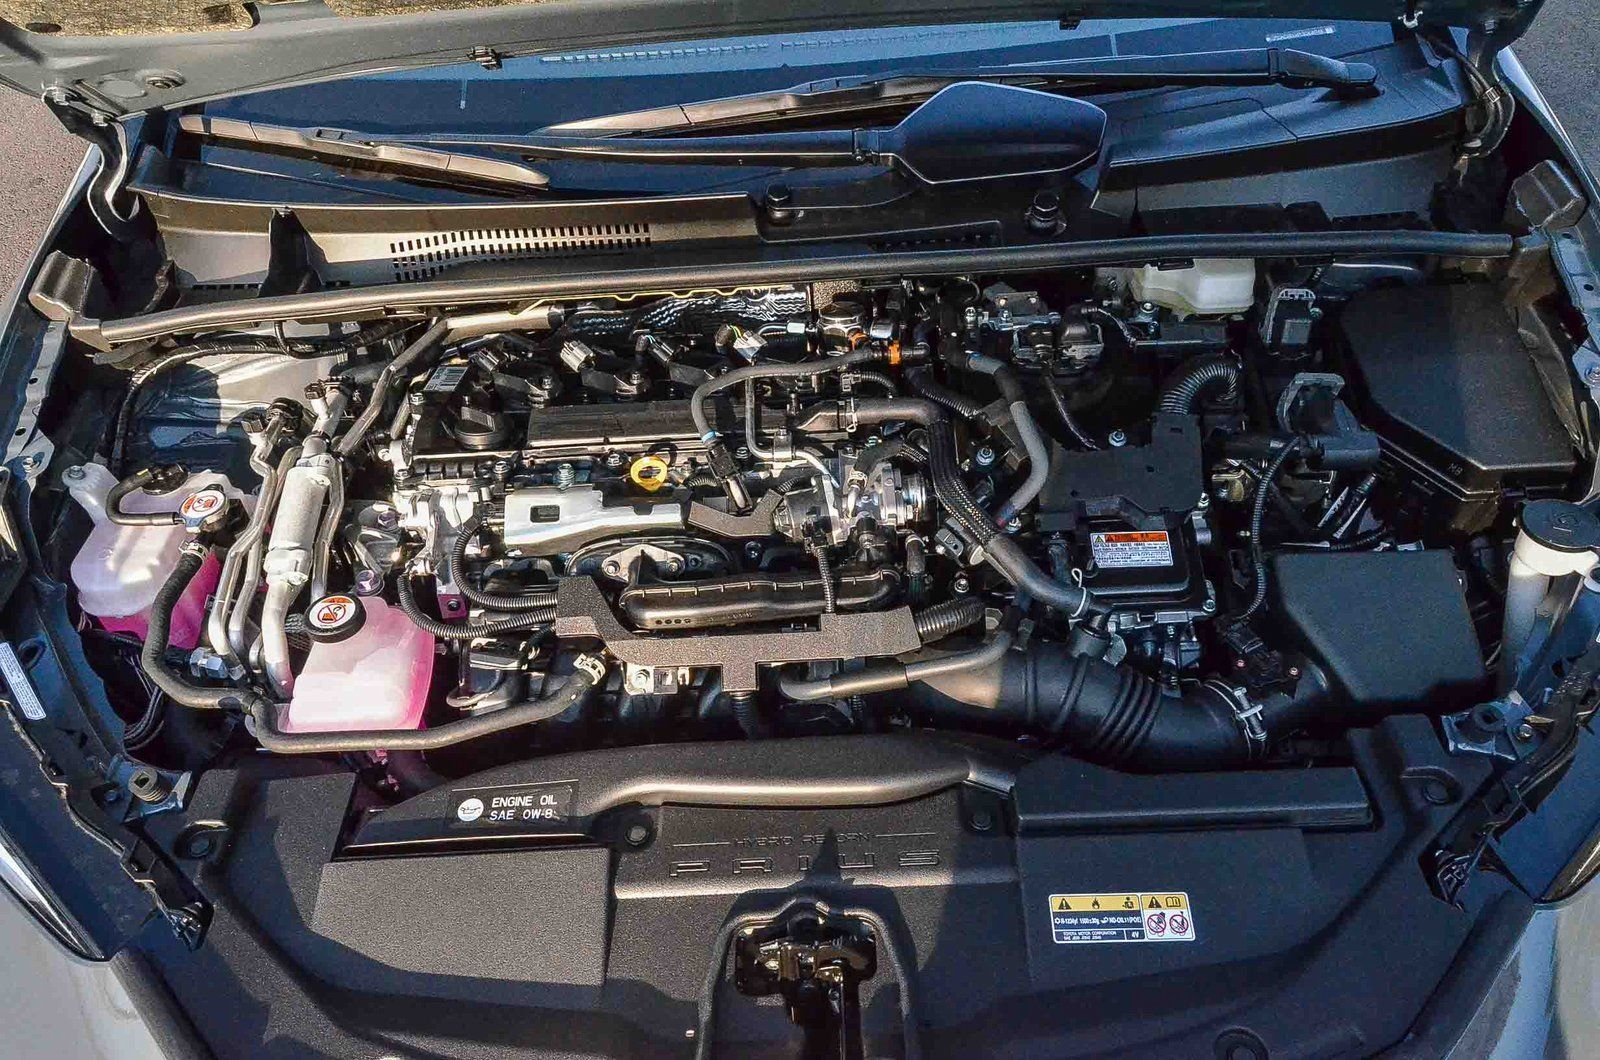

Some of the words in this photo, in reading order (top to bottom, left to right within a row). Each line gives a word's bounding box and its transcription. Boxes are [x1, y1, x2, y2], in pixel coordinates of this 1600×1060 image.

[491, 795, 533, 808] ENGINE
[540, 794, 558, 806] OIL
[489, 809, 515, 821] SAE
[522, 808, 553, 820] 0W-8
[801, 832, 870, 846] REORN
[668, 849, 941, 877] PRIUS
